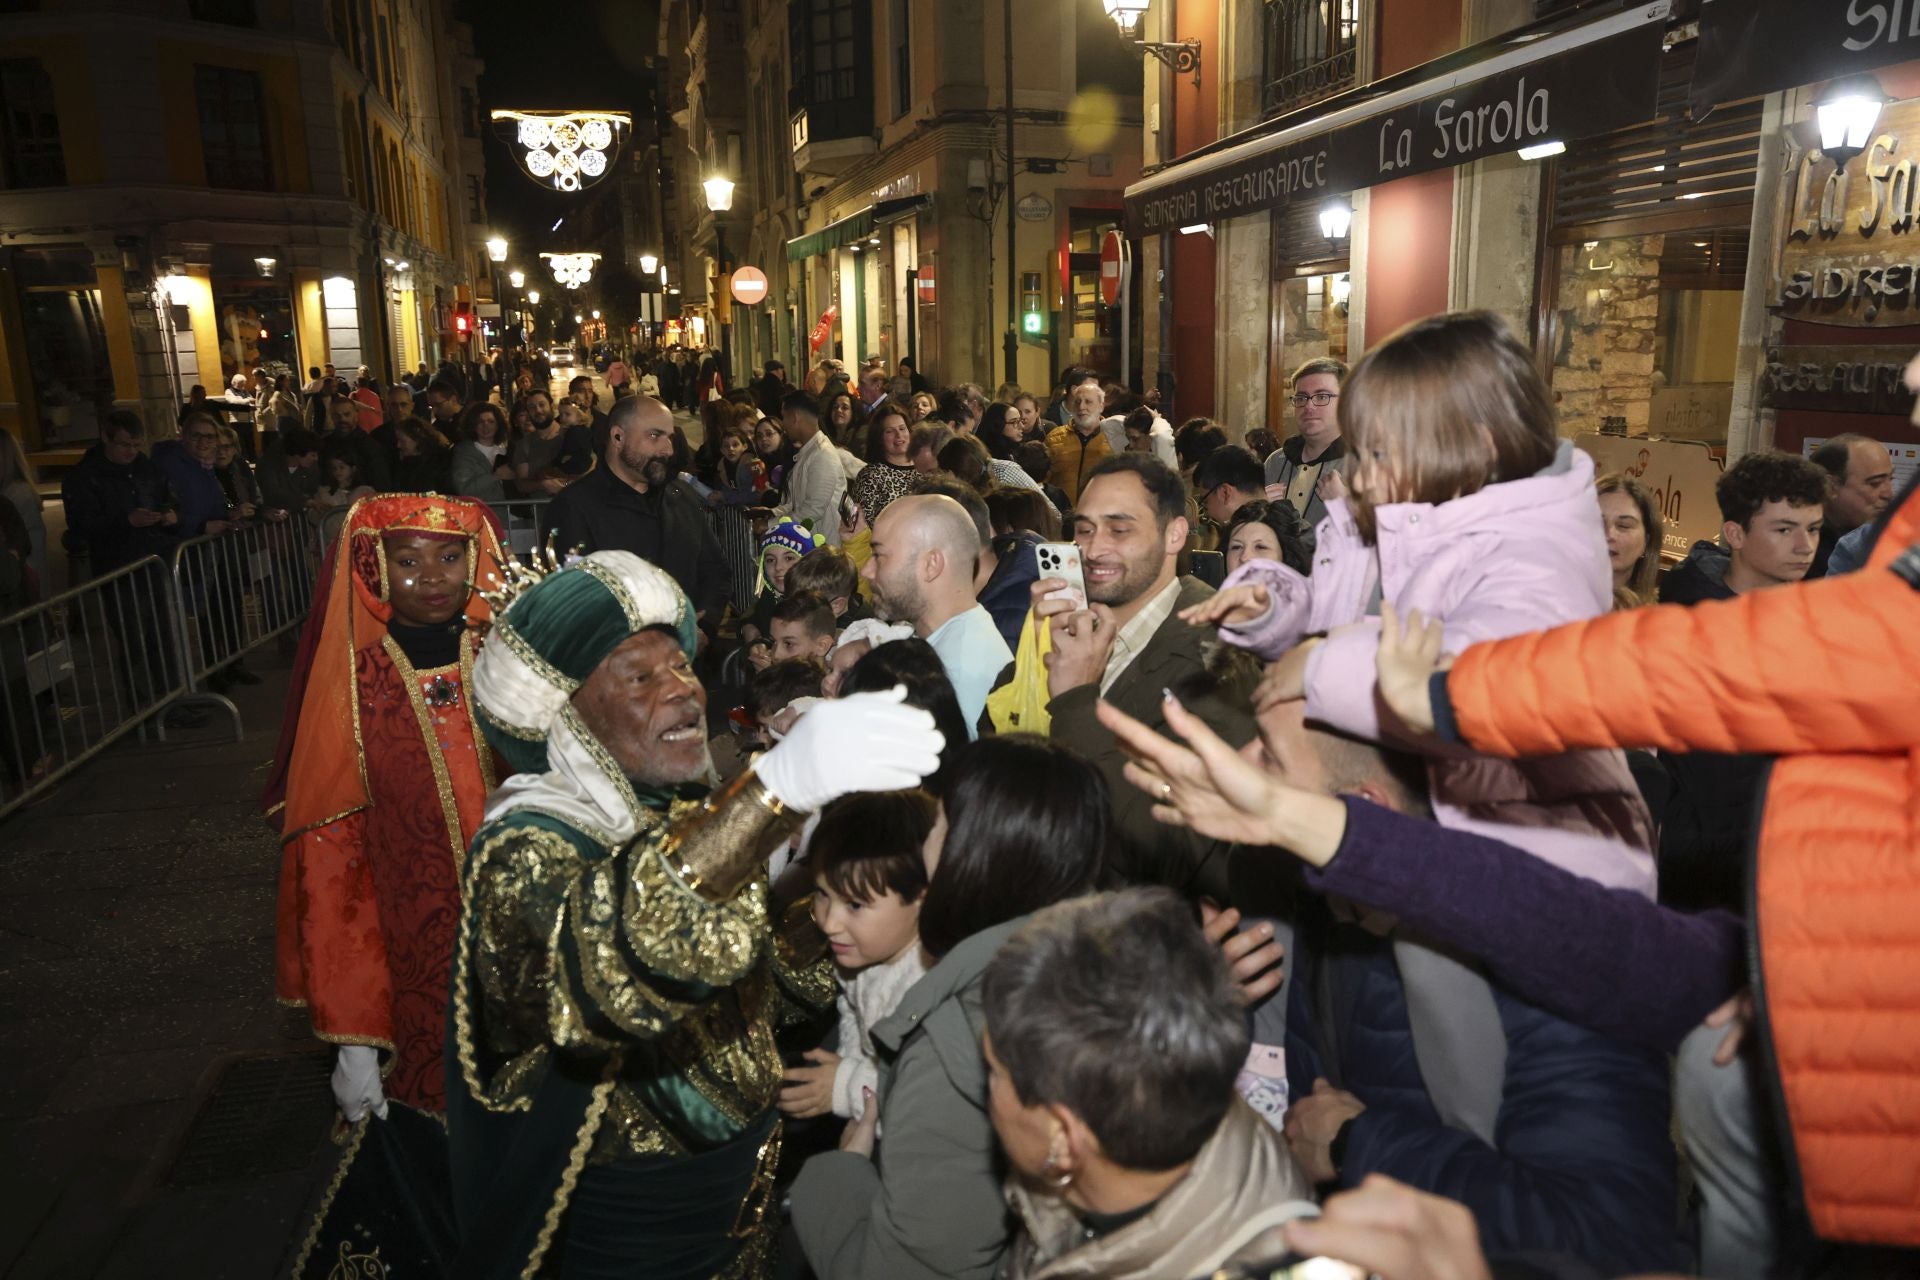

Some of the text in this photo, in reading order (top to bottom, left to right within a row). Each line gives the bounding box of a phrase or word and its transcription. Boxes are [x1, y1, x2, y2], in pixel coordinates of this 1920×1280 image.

[1379, 77, 1549, 173] La Farola
[1144, 150, 1327, 228] SIDRERIA RESTAURANTE
